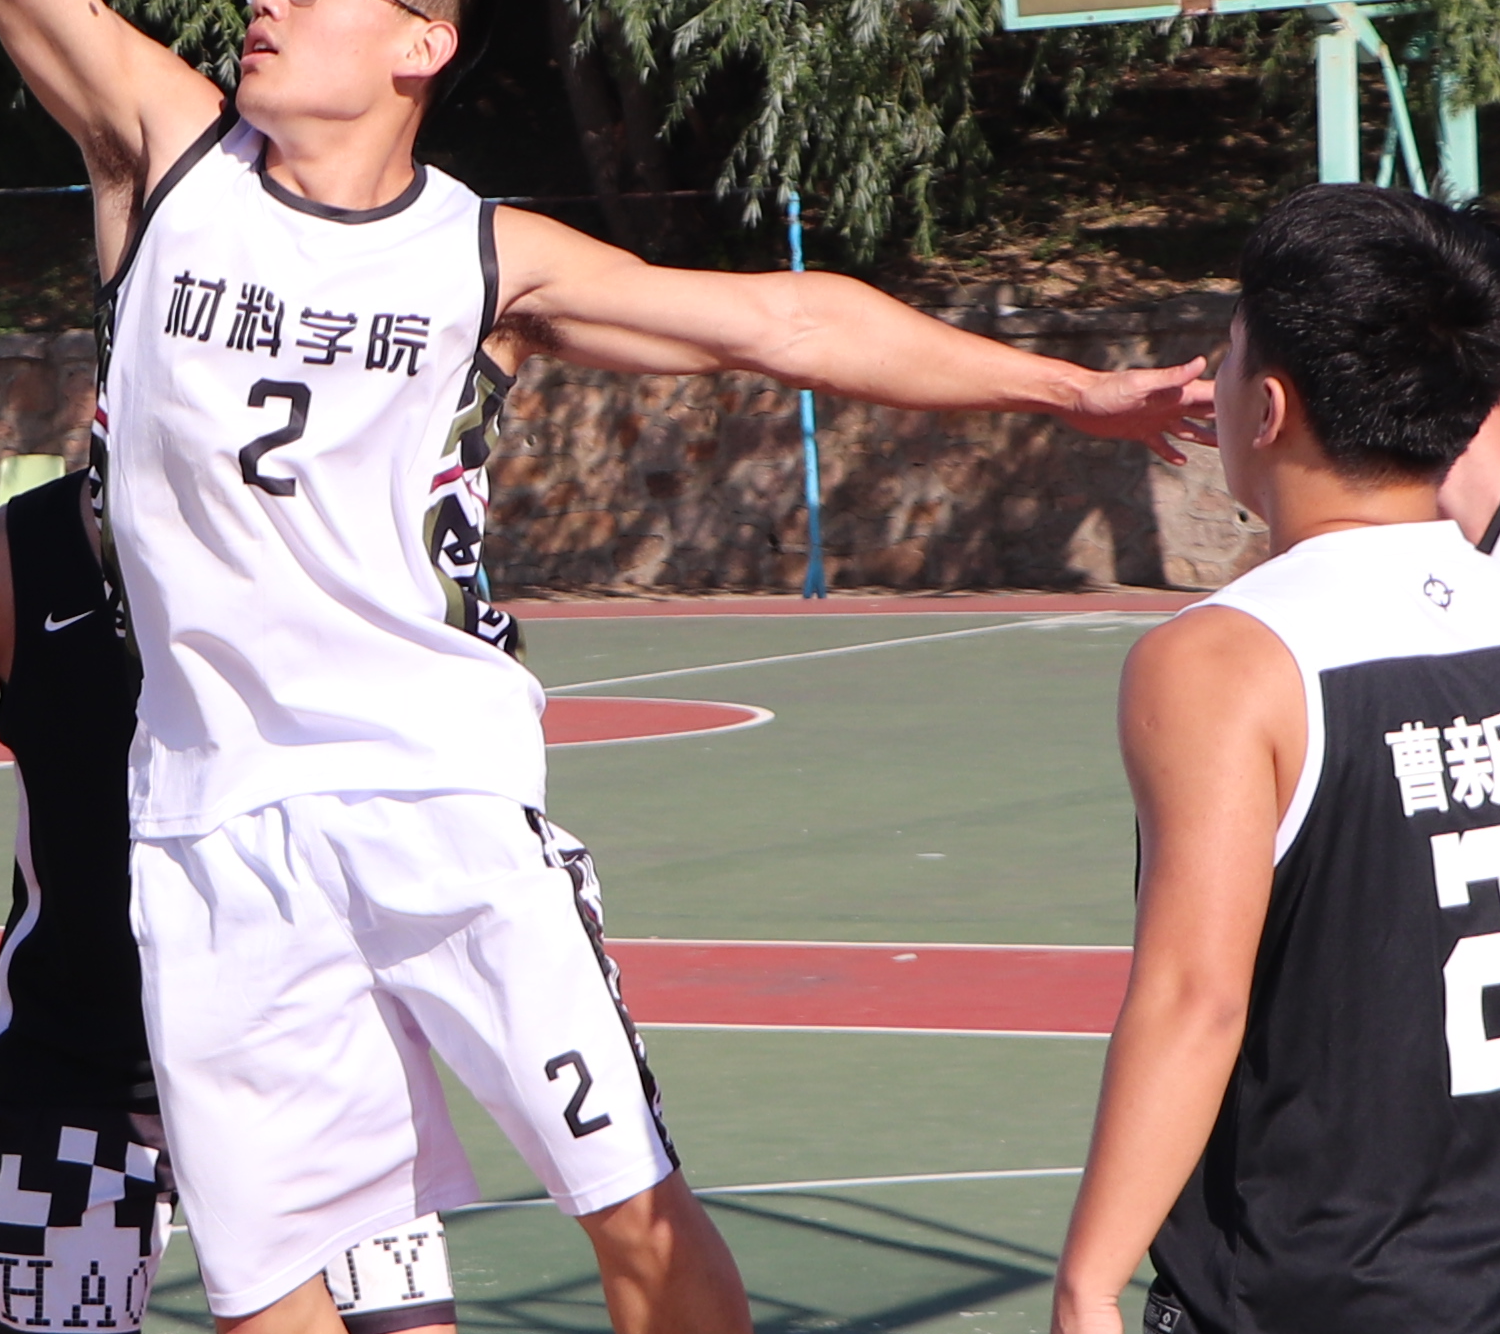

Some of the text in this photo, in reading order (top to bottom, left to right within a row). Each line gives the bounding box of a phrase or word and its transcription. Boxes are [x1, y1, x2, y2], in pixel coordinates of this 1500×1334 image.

[165, 270, 430, 377] 材料学院
[239, 378, 312, 496] 2
[544, 1049, 613, 1140] 2
